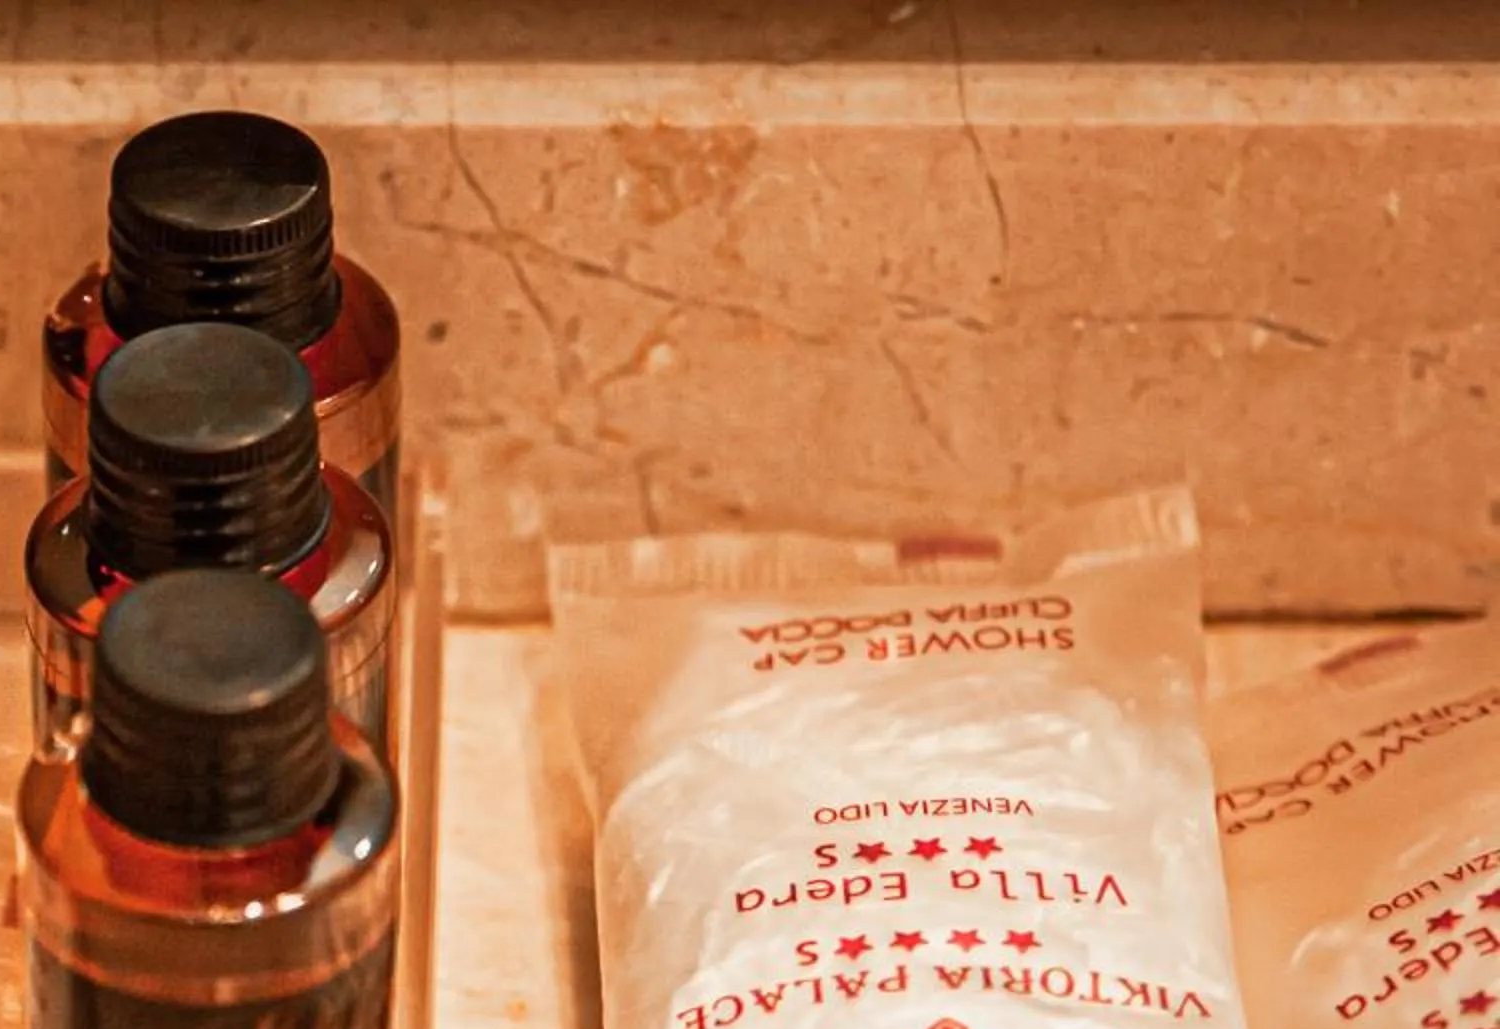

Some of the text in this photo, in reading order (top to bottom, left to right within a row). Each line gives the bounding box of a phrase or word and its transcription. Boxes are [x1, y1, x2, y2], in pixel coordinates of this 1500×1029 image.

[738, 610, 914, 645] DOCCIA
[751, 625, 1075, 672] SHOWER CAP
[814, 796, 1034, 825] VENEZIA LIDO
[815, 842, 838, 867] S
[735, 871, 1129, 914] Villa Edera
[1367, 879, 1442, 921] LIDO
[795, 939, 820, 967] S
[1387, 928, 1417, 954] S
[934, 964, 1213, 1019] VIKTORIA
